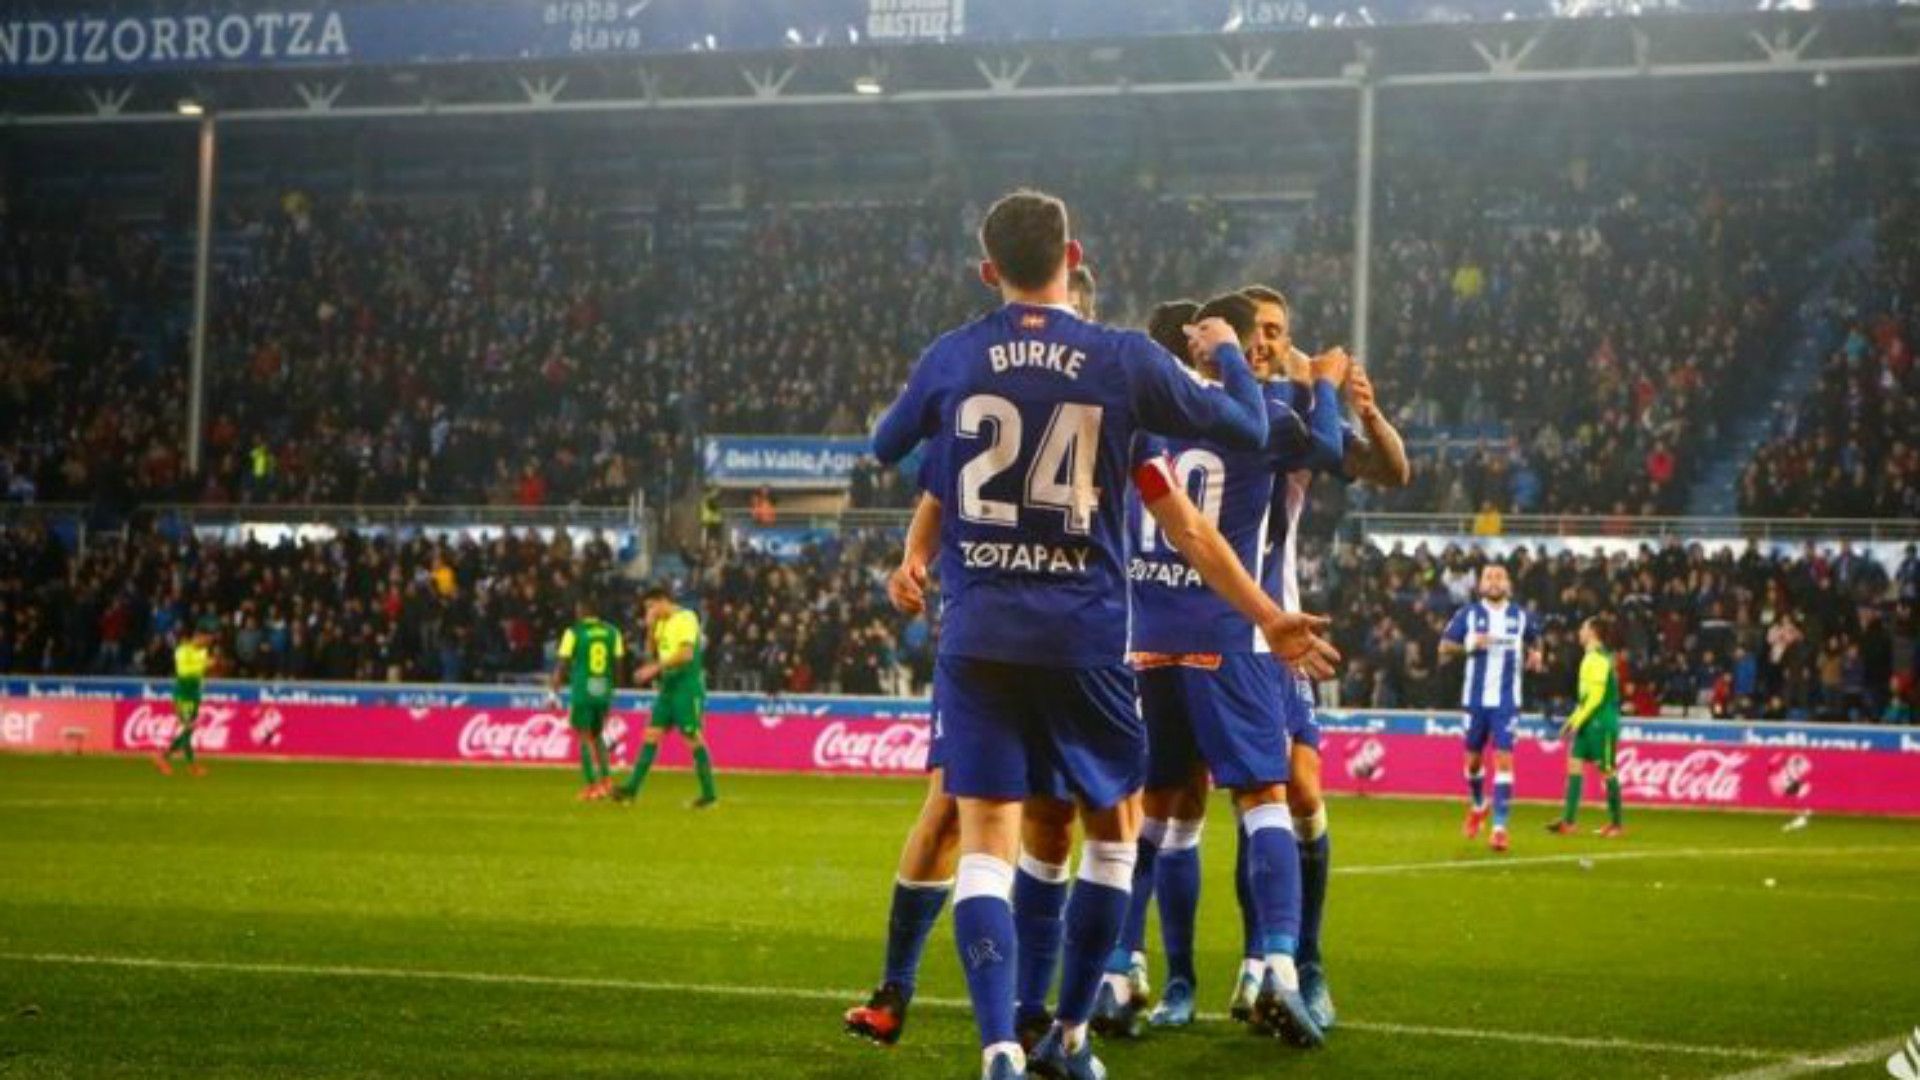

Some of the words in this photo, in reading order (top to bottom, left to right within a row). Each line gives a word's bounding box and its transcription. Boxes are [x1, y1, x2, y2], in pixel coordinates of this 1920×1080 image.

[989, 342, 1085, 379] BURKE
[763, 448, 816, 473] Valle
[956, 394, 1103, 536] 24
[589, 641, 607, 674] 8
